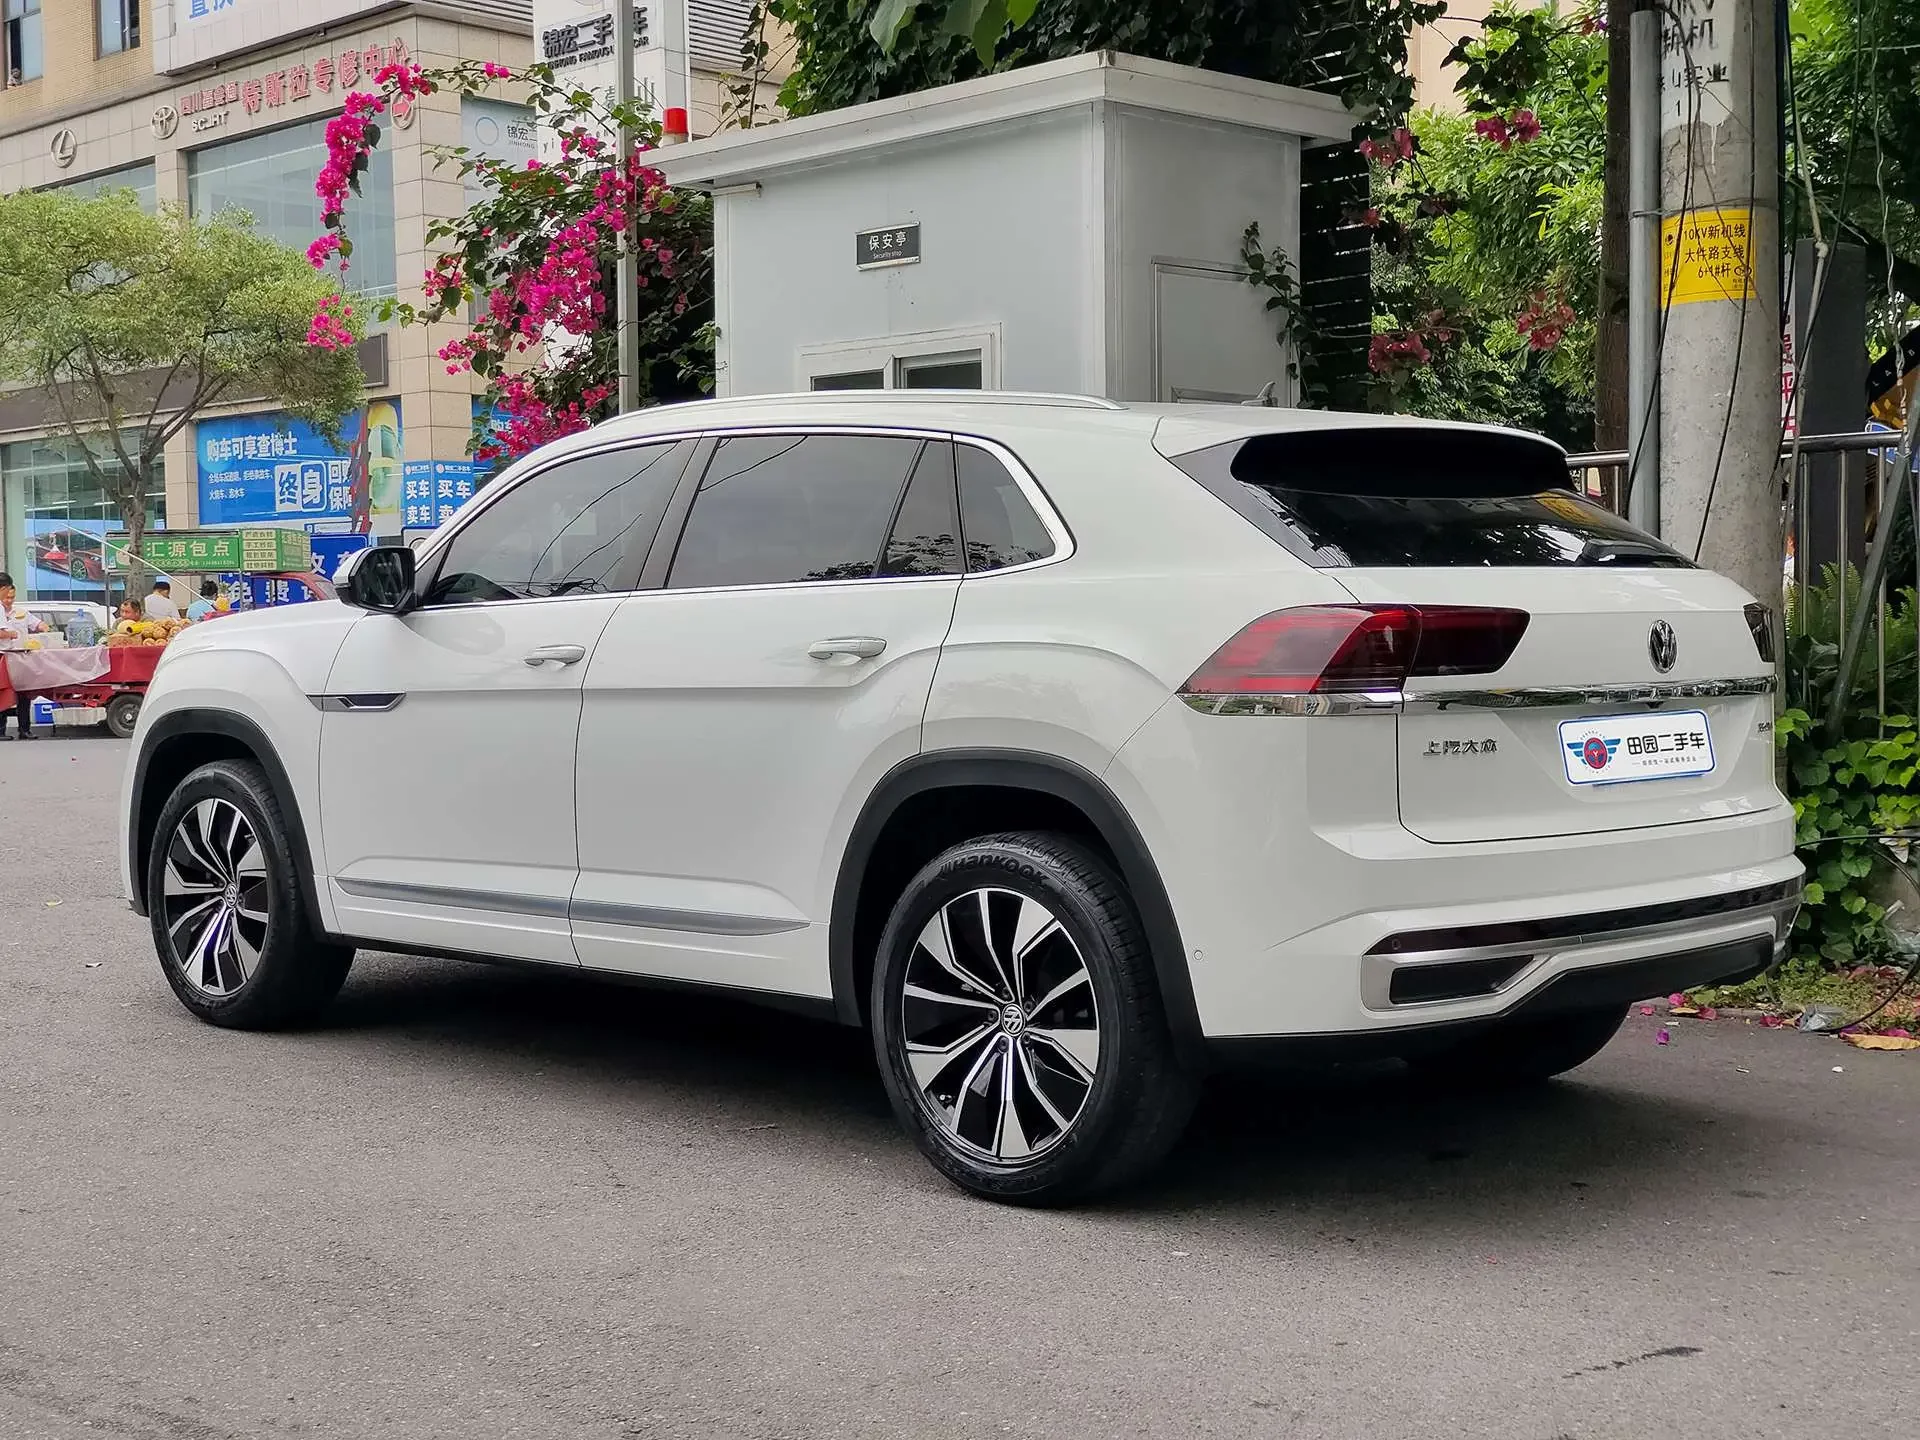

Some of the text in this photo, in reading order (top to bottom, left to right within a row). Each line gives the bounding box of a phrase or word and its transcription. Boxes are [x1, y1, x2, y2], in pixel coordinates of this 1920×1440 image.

[542, 6, 649, 58] 锦宏二手车
[241, 36, 408, 114] 特斯拉专修中心
[869, 231, 906, 251] 保安亭
[206, 431, 298, 462] 购车可享查博士
[278, 469, 323, 505] 终身
[405, 479, 430, 500] 买车
[437, 479, 472, 499] 买车
[406, 504, 431, 525] 卖车
[146, 541, 230, 558] 汇源包点
[1423, 738, 1498, 756] 上汽大众
[1627, 731, 1706, 756] 田园二手车
